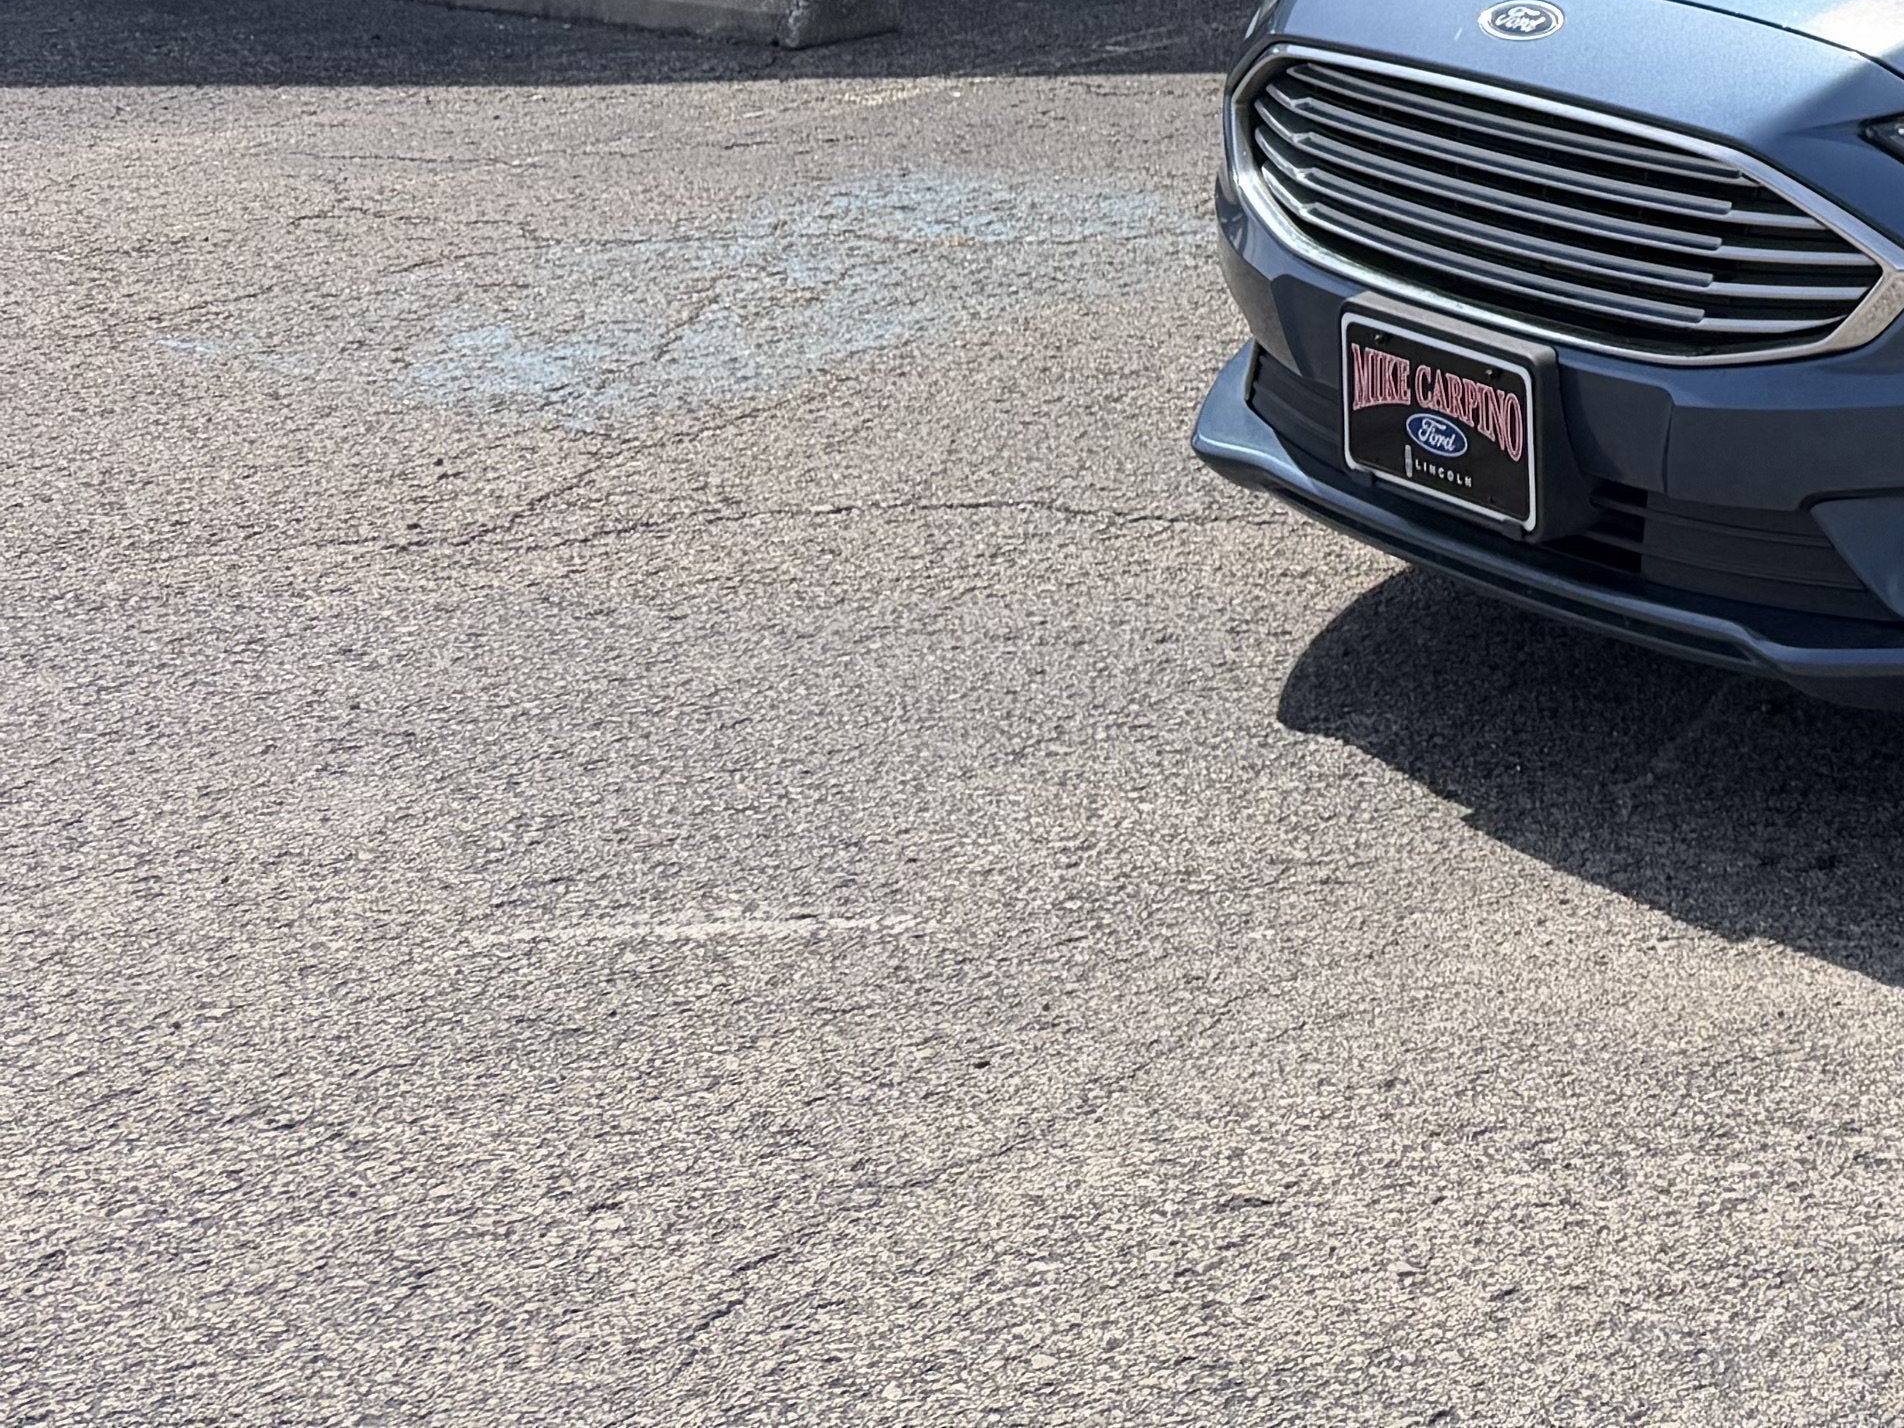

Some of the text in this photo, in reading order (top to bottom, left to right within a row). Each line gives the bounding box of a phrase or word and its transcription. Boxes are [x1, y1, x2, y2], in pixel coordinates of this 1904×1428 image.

[1495, 6, 1547, 33] Ford
[1351, 343, 1524, 462] MIKE CARPINO
[1417, 417, 1456, 452] Ford
[1415, 458, 1472, 488] LINCOLN
